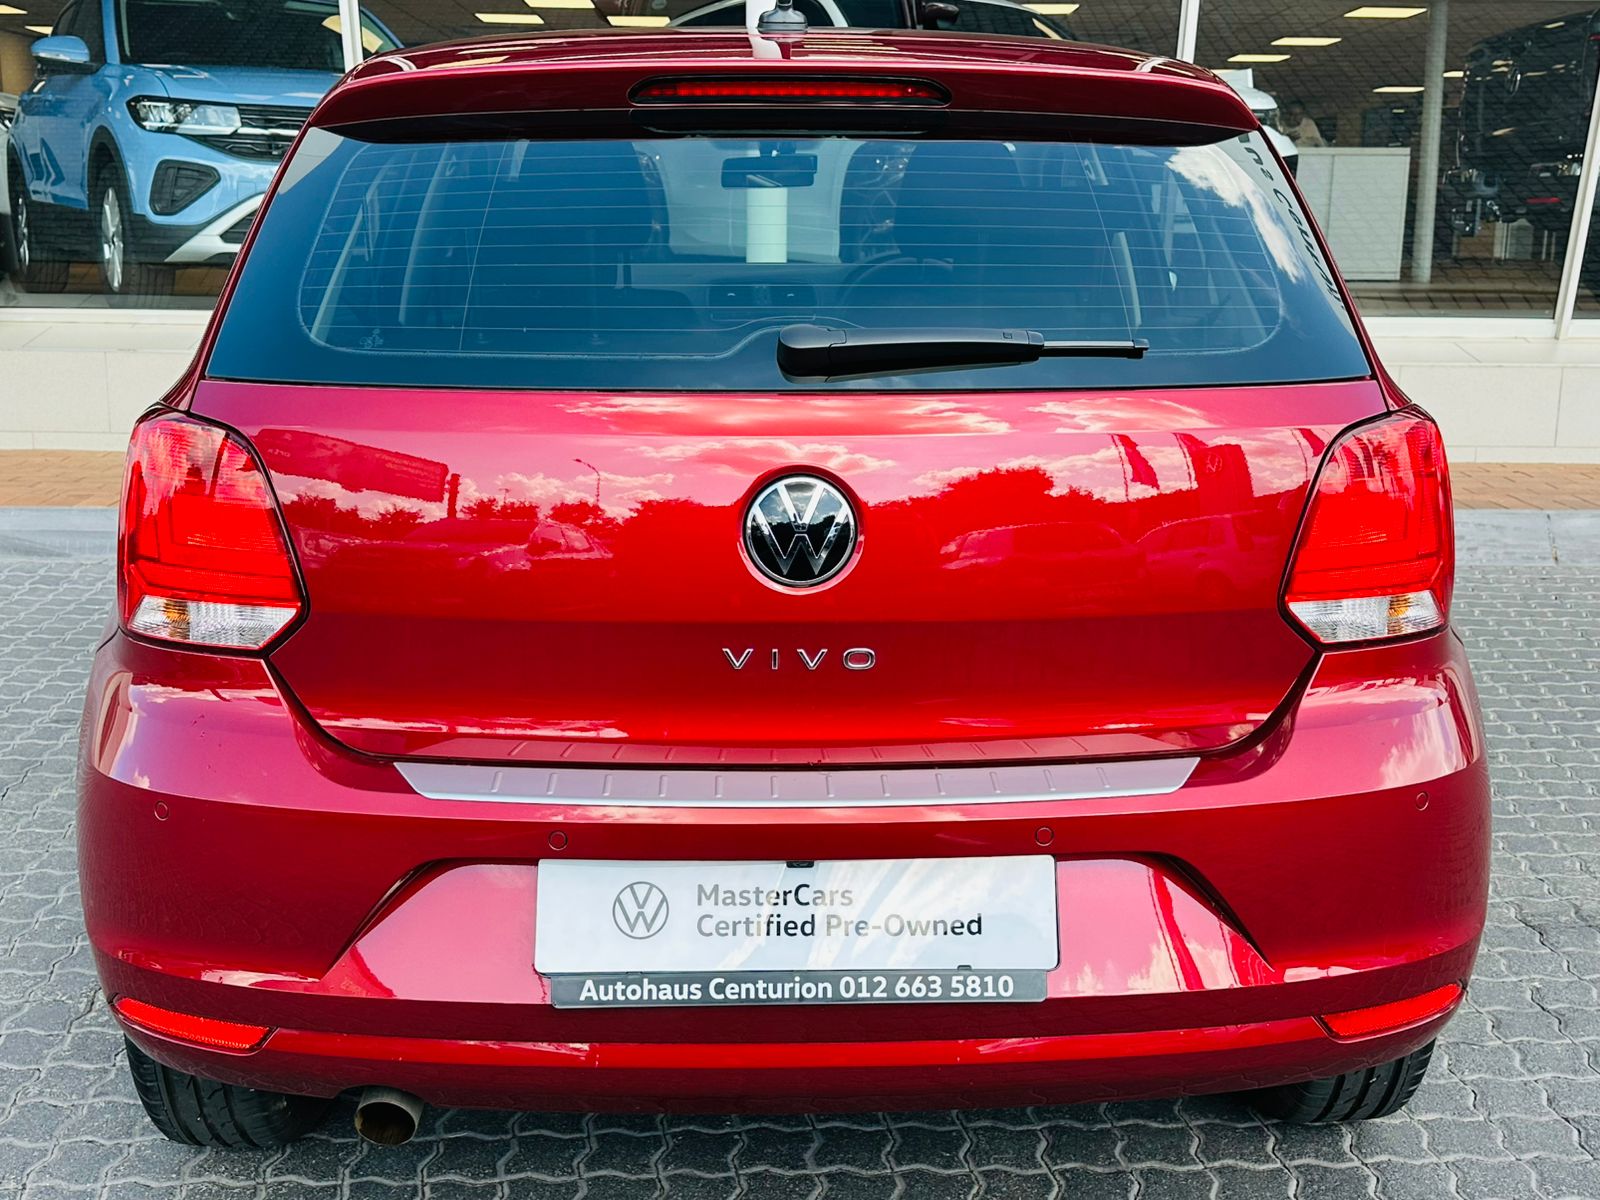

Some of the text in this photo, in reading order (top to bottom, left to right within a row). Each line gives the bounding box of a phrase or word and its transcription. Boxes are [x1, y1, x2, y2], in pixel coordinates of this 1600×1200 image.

[746, 476, 855, 585] VW
[722, 647, 876, 670] VIVO
[696, 883, 854, 907] MasterCars
[613, 881, 669, 939] VW
[696, 912, 983, 938] Certified Pre-Owned
[579, 974, 1015, 1001] Autohaus Centurion 012 663 5810
